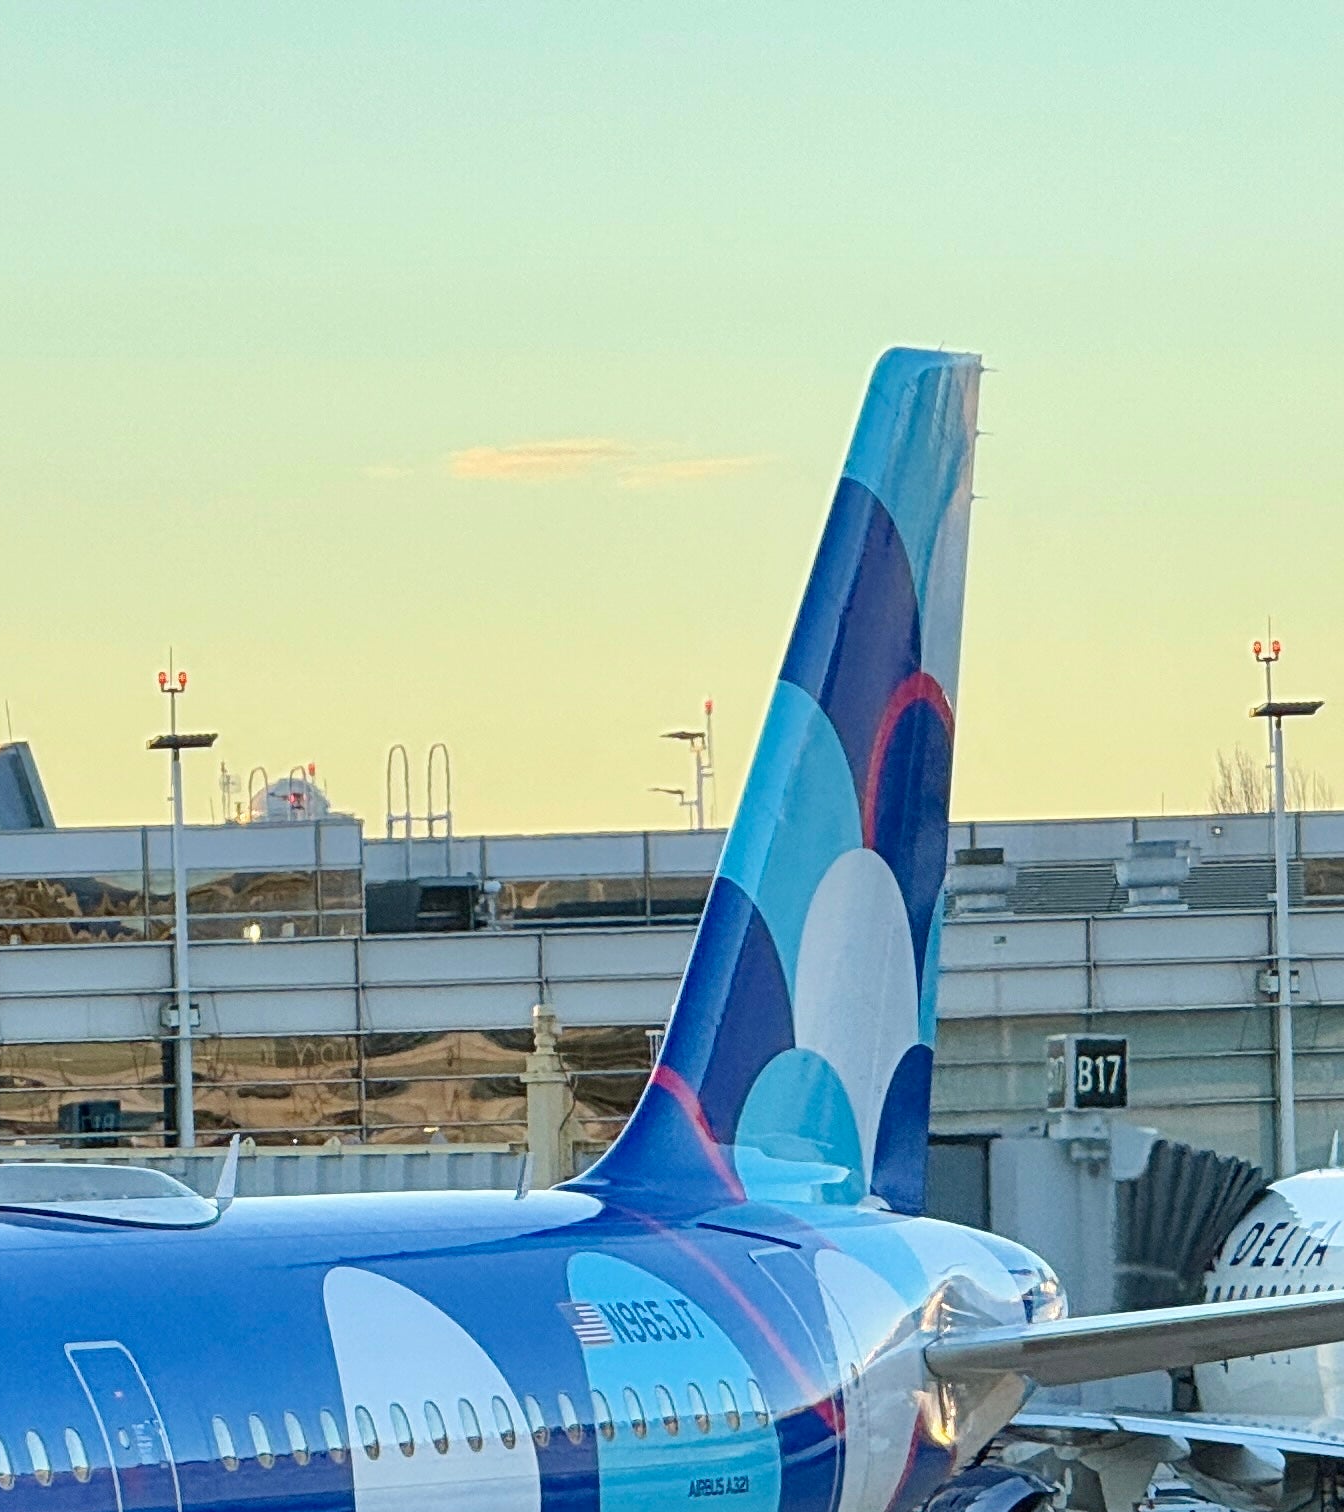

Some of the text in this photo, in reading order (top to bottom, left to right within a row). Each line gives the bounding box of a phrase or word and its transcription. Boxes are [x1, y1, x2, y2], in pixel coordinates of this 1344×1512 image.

[1078, 1055, 1121, 1094] B17
[1230, 1221, 1341, 1266] DELTA
[598, 1299, 704, 1343] N965JT
